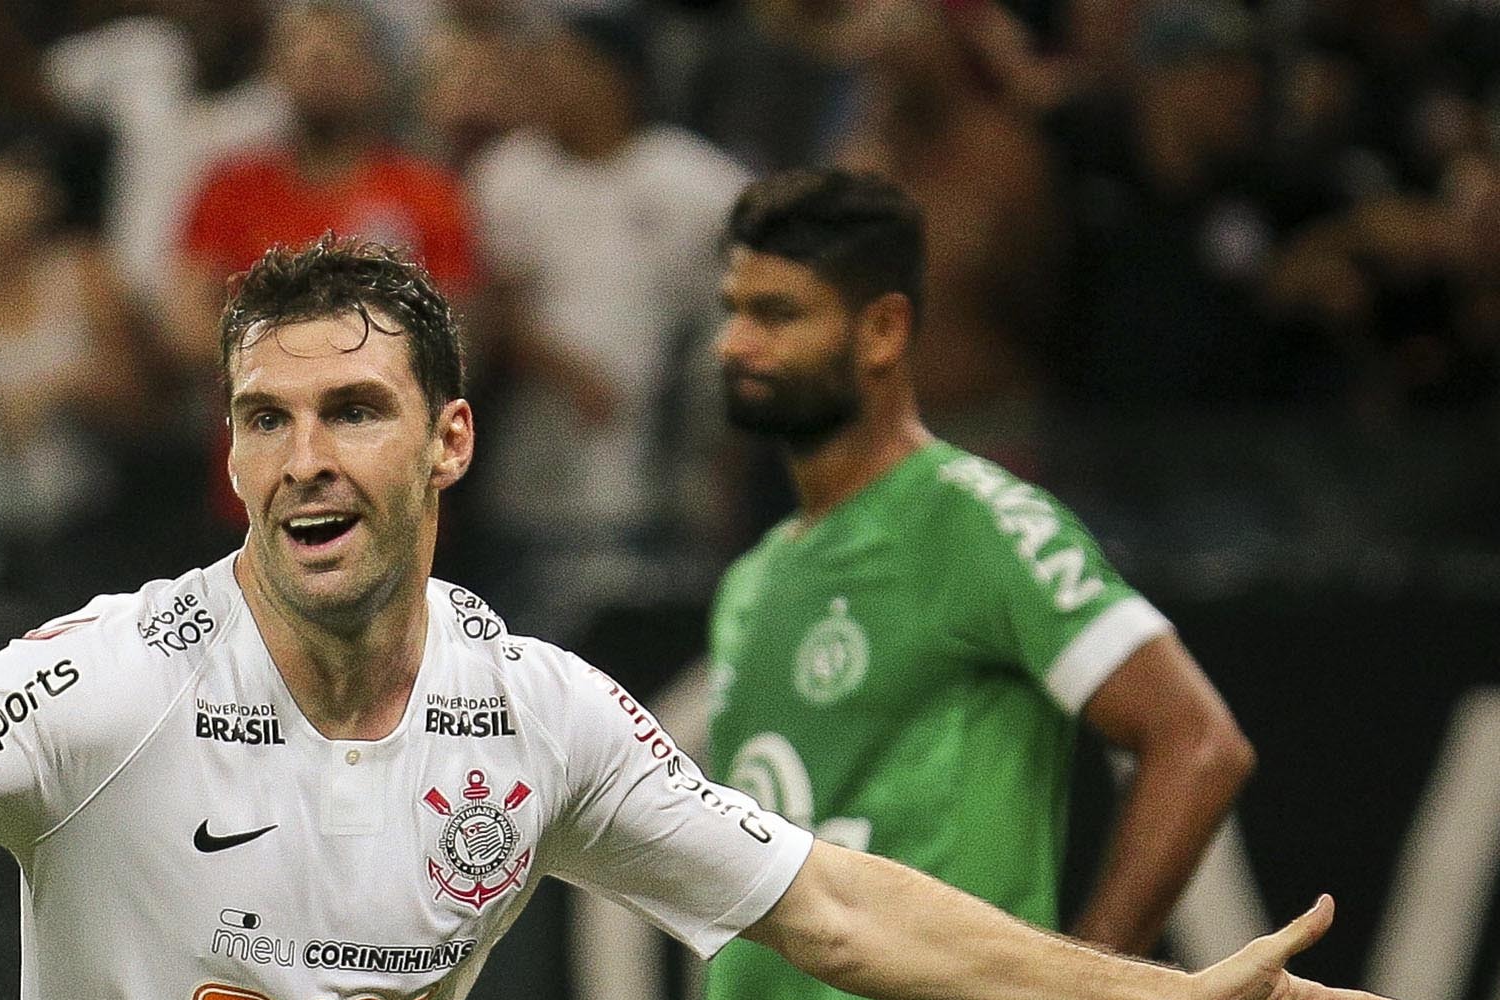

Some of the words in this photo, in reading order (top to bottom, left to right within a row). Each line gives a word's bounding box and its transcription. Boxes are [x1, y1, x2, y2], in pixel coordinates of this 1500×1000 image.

[174, 594, 199, 616] de
[450, 602, 523, 661] TODS
[195, 712, 286, 746] BRASIL
[425, 707, 517, 738] BRASIL
[212, 928, 296, 967] meu
[302, 939, 477, 974] CORINTHIANS
